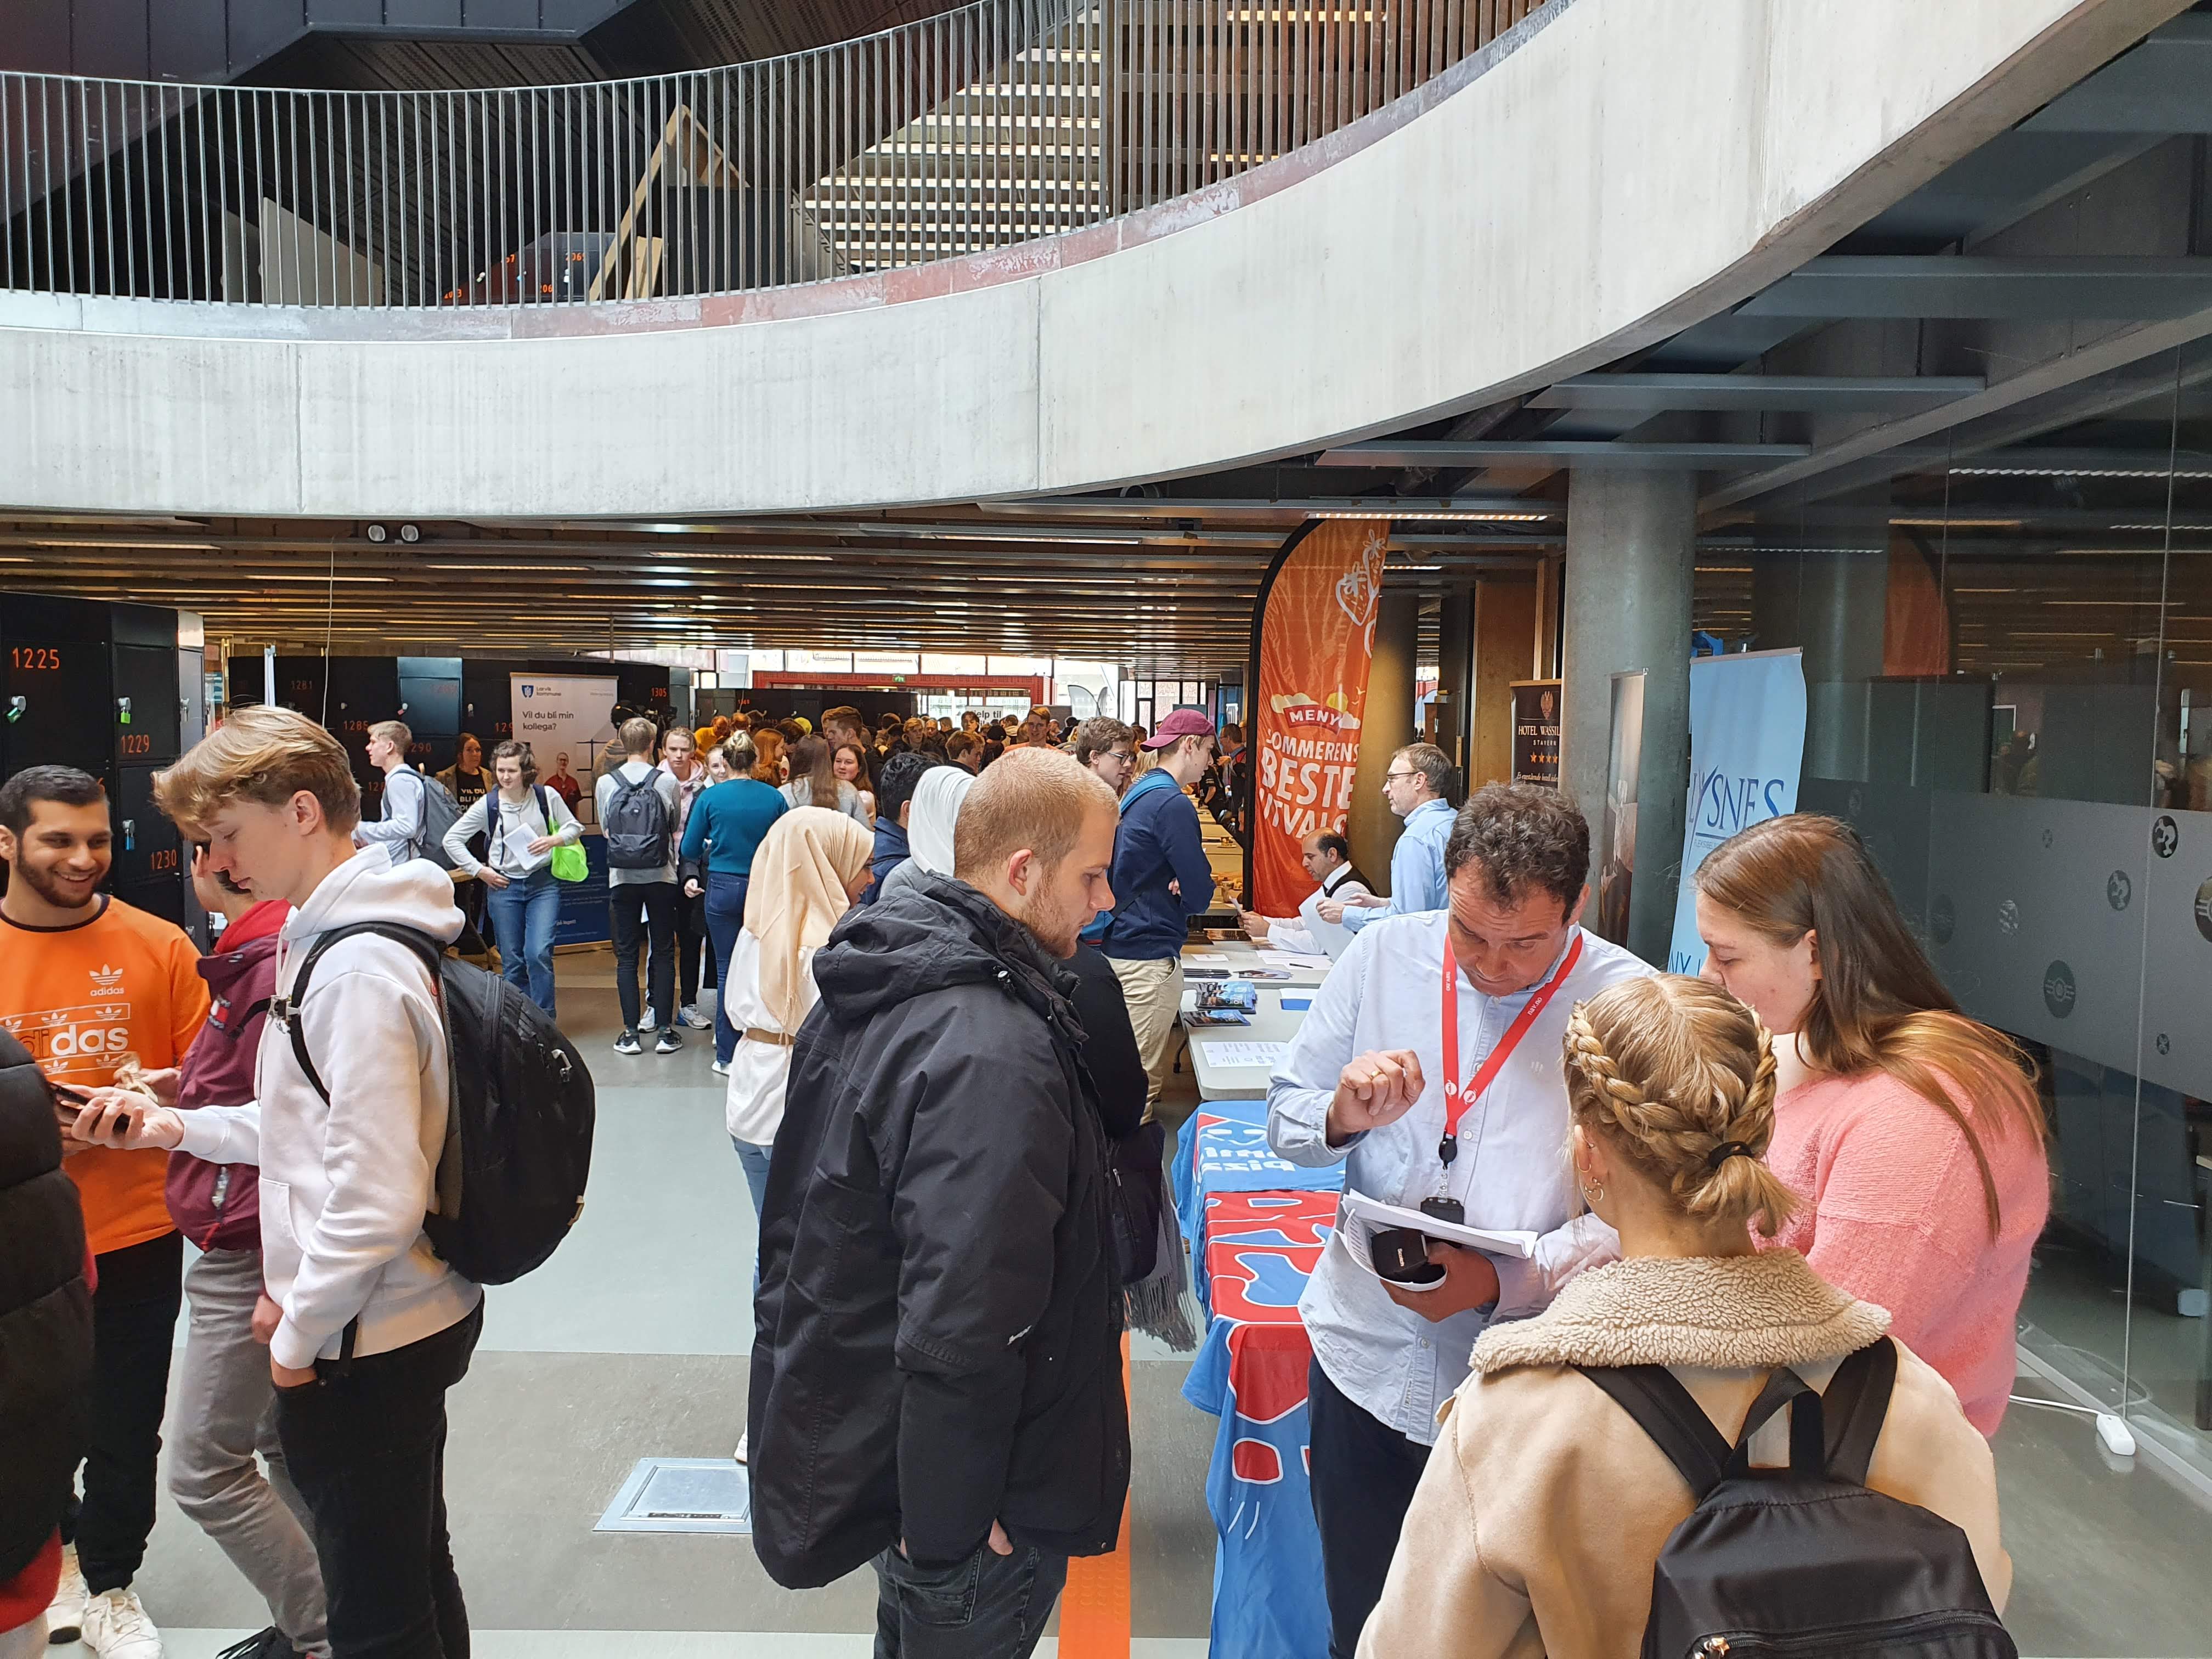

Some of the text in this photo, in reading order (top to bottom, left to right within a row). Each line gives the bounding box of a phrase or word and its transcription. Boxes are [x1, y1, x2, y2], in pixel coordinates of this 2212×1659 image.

[12, 647, 60, 669] 1225
[651, 687, 668, 697] 1305
[522, 711, 533, 719] Vil
[548, 711, 557, 719] bli
[558, 711, 574, 719] min
[993, 710, 1002, 718] til
[1289, 709, 1340, 726] MENY
[495, 722, 513, 733] 129
[523, 723, 557, 732] kollega?
[1518, 725, 1560, 736] HOTEL WASSIL
[120, 734, 150, 754] 1229
[411, 742, 432, 753] 290
[1261, 746, 1357, 810] BESTE
[150, 849, 177, 870] 1230
[90, 987, 125, 997] adidas
[1527, 997, 1542, 1015] nav.no
[18, 1024, 129, 1059] didas
